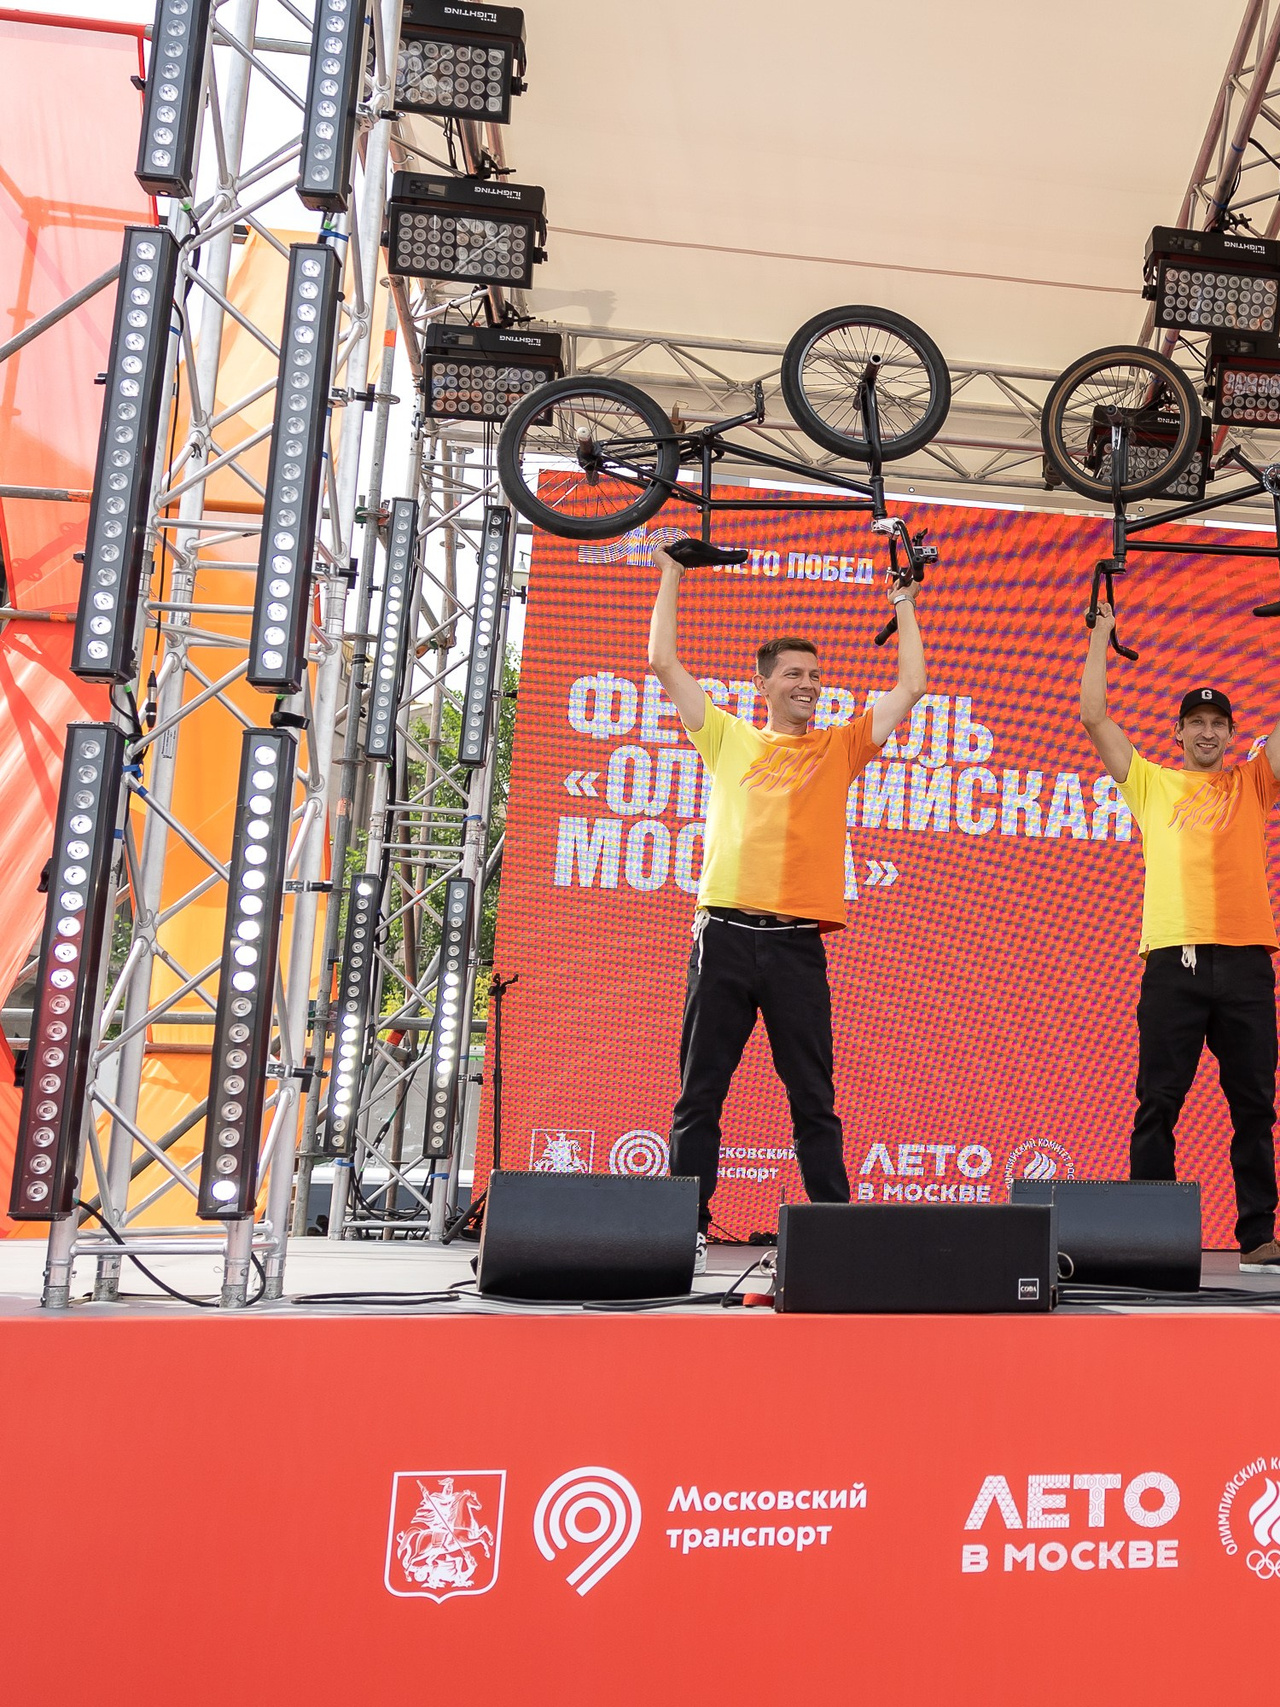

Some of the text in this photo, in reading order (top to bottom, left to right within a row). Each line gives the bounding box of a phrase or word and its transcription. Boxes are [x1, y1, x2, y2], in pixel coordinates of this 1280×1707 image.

[787, 551, 875, 585] ПОБЕД
[1201, 690, 1213, 700] G
[568, 671, 995, 769] ФЕТВЛЬ
[564, 744, 1133, 842] «ОЛИЙСКАЯ
[553, 815, 900, 900] МОС»
[718, 1144, 798, 1160] сковский
[859, 1143, 993, 1178] ЛЕТО
[717, 1166, 779, 1182] нспорт
[857, 1182, 991, 1203] В МОСКВЕ
[667, 1482, 868, 1512] Московский
[963, 1471, 1181, 1531] ЛЕТО
[1218, 1457, 1267, 1556] ОЛИМПИЙСКИЙ
[665, 1525, 833, 1555] транспорт
[961, 1539, 1179, 1573] В МОСКВЕ
